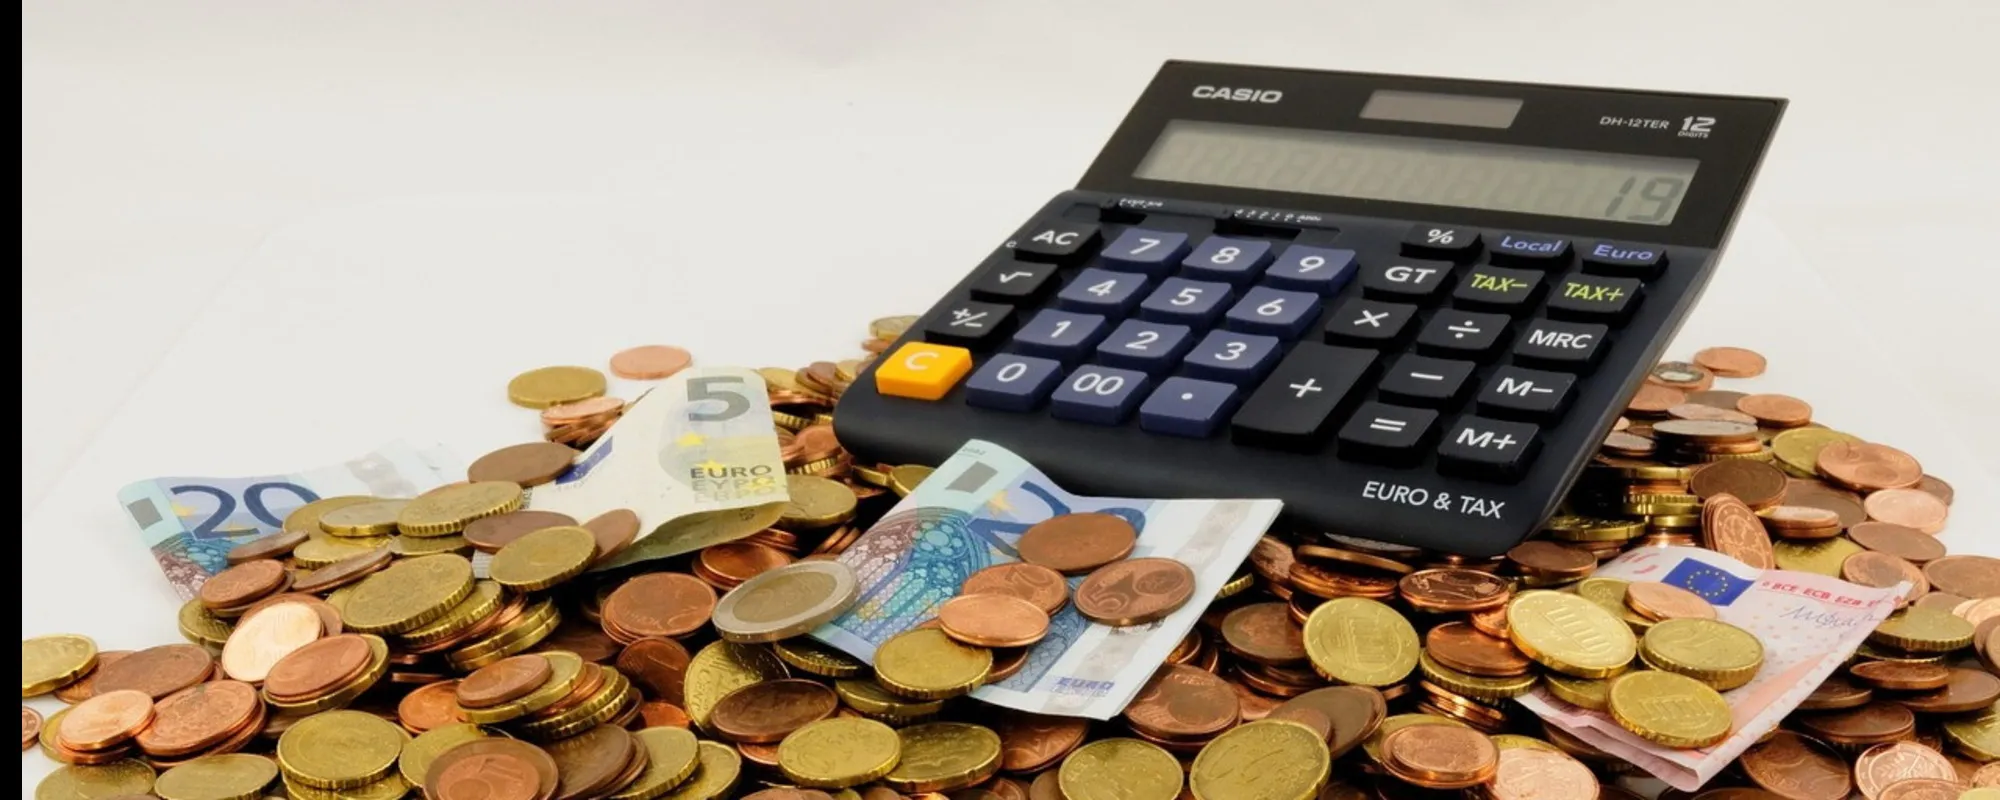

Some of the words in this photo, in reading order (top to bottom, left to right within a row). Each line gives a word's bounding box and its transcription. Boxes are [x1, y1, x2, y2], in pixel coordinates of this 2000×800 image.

[1192, 85, 1283, 103] CASIO
[1599, 116, 1670, 129] DH-12TER
[1681, 116, 1716, 132] 12
[1605, 176, 1684, 221] 19
[1032, 230, 1079, 246] AC
[1130, 237, 1161, 255] 7
[1501, 235, 1563, 252] Local
[1210, 246, 1241, 264] 8
[1593, 244, 1654, 261] Euro
[1298, 255, 1325, 273] 9
[1384, 266, 1437, 284] GT
[1087, 279, 1117, 297] 4
[1170, 287, 1203, 306] 5
[1256, 298, 1285, 316] 6
[1050, 320, 1072, 338] 1
[1125, 331, 1159, 350] 2
[1527, 329, 1593, 349] MRC
[904, 351, 940, 370] C
[1214, 342, 1247, 361] 3
[1072, 372, 1124, 396] 00
[686, 376, 750, 421] 5
[1456, 427, 1517, 450] M+
[690, 465, 772, 479] EURO
[1362, 480, 1429, 506] EURO
[1433, 492, 1452, 511] &
[1459, 495, 1506, 519] TAX
[1772, 582, 1799, 592] BCE
[1803, 587, 1833, 600] ECB
